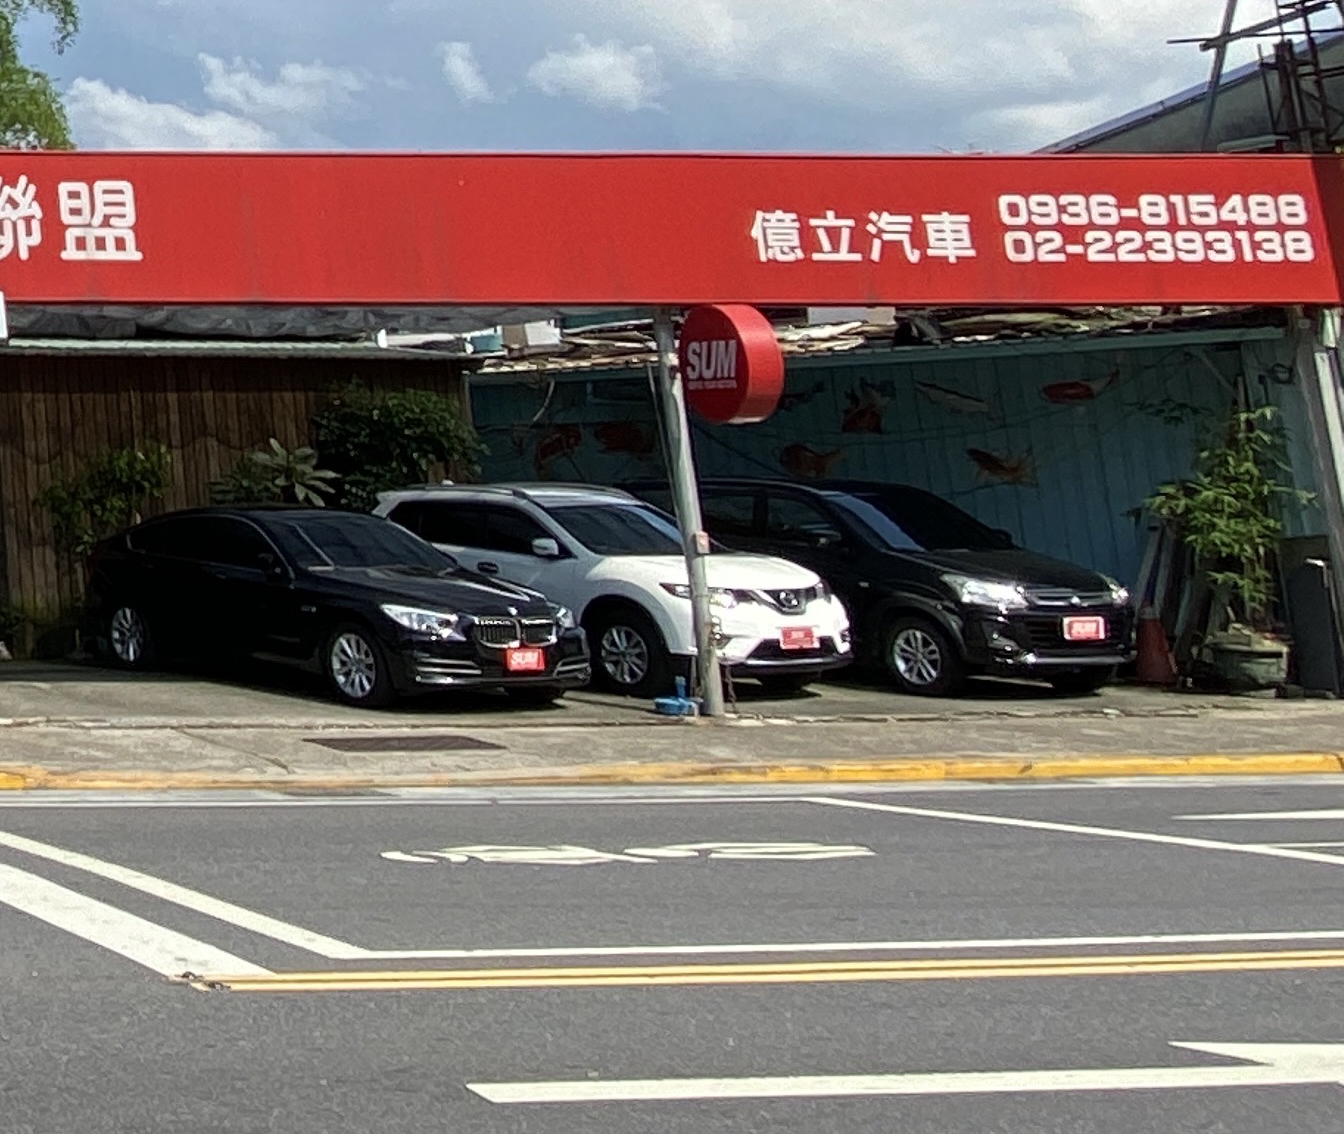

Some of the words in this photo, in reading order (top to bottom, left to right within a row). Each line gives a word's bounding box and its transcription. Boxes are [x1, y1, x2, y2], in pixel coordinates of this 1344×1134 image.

[997, 193, 1309, 227] 0936-815488
[749, 209, 977, 264] 億立汽車
[1005, 230, 1315, 264] 02-22393138
[686, 340, 738, 379] SUM
